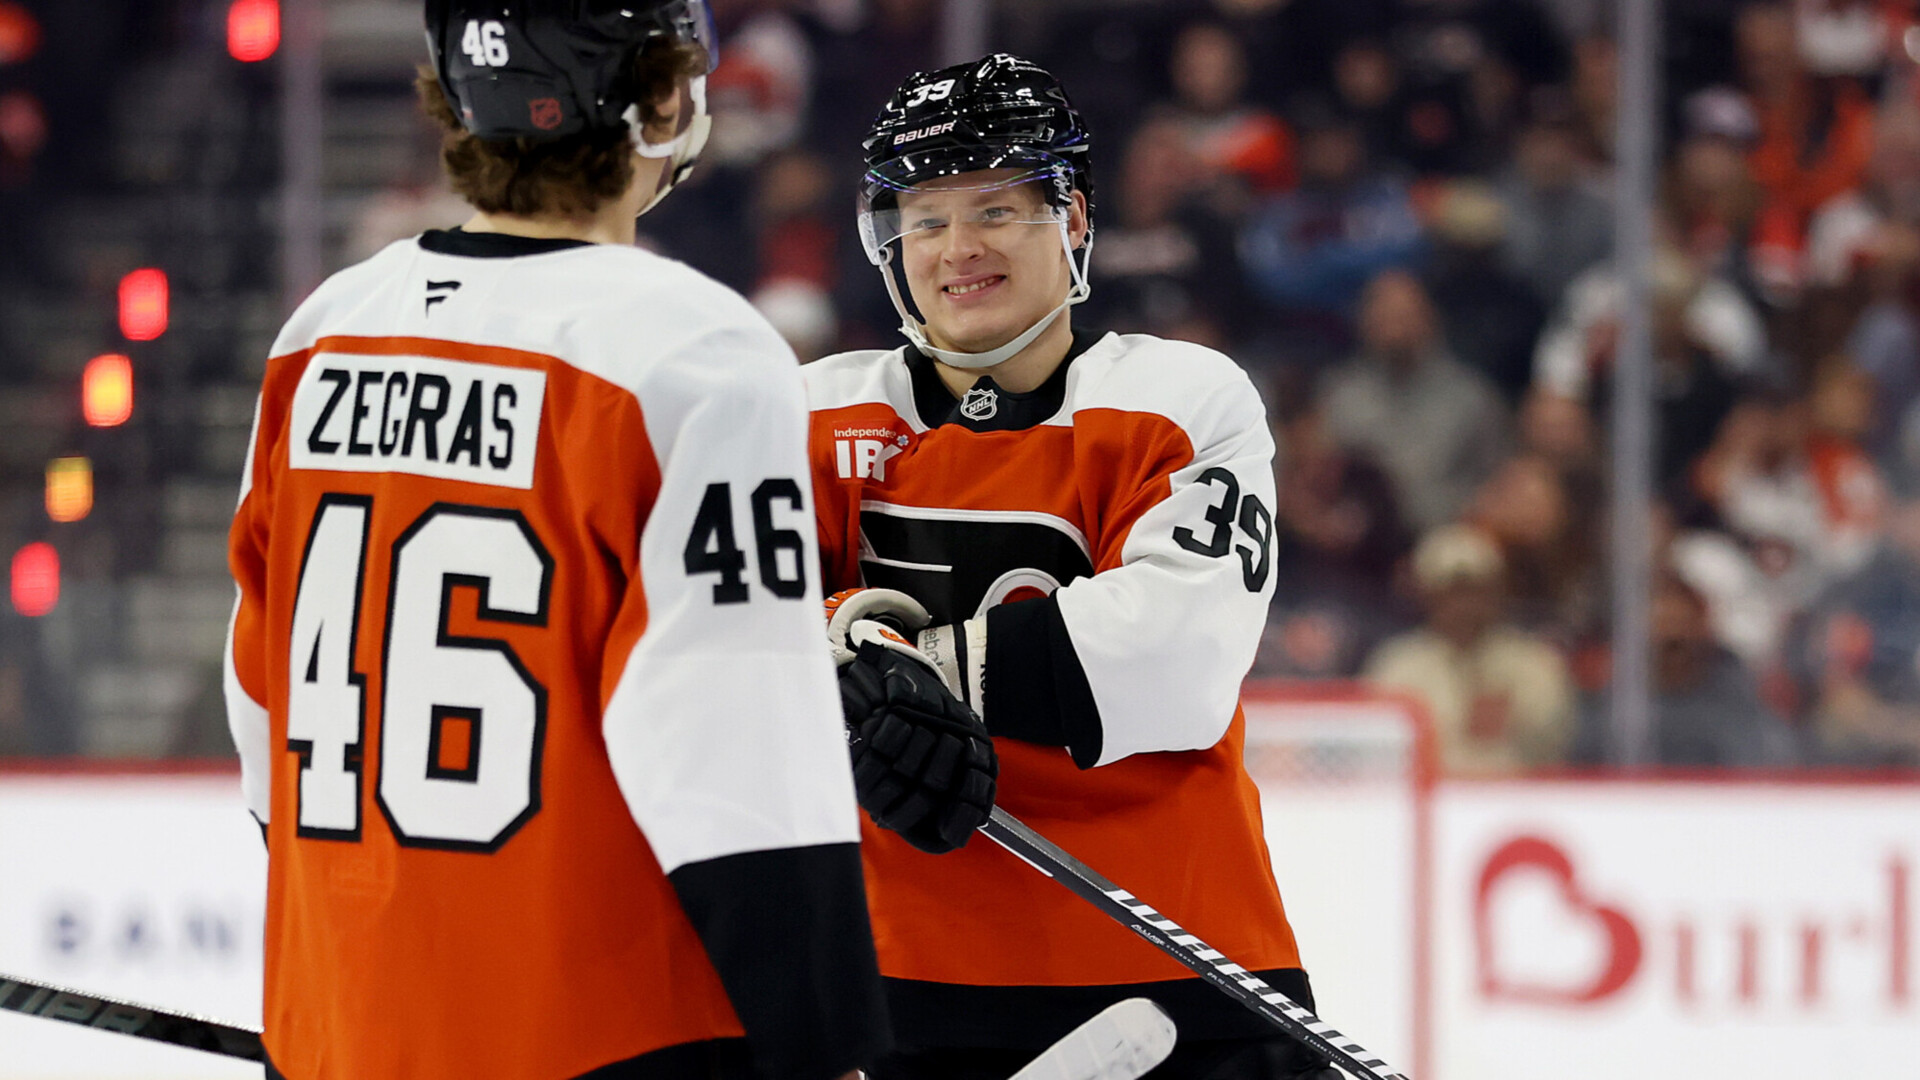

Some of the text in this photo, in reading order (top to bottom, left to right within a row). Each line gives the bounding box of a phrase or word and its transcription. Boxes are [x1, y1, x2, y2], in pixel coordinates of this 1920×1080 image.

[461, 19, 509, 67] 46
[906, 79, 956, 108] 39
[893, 121, 955, 145] BAUER
[307, 368, 517, 470] ZEGRAS
[683, 478, 806, 605] 46
[1172, 467, 1272, 592] 39
[286, 493, 556, 854] 46
